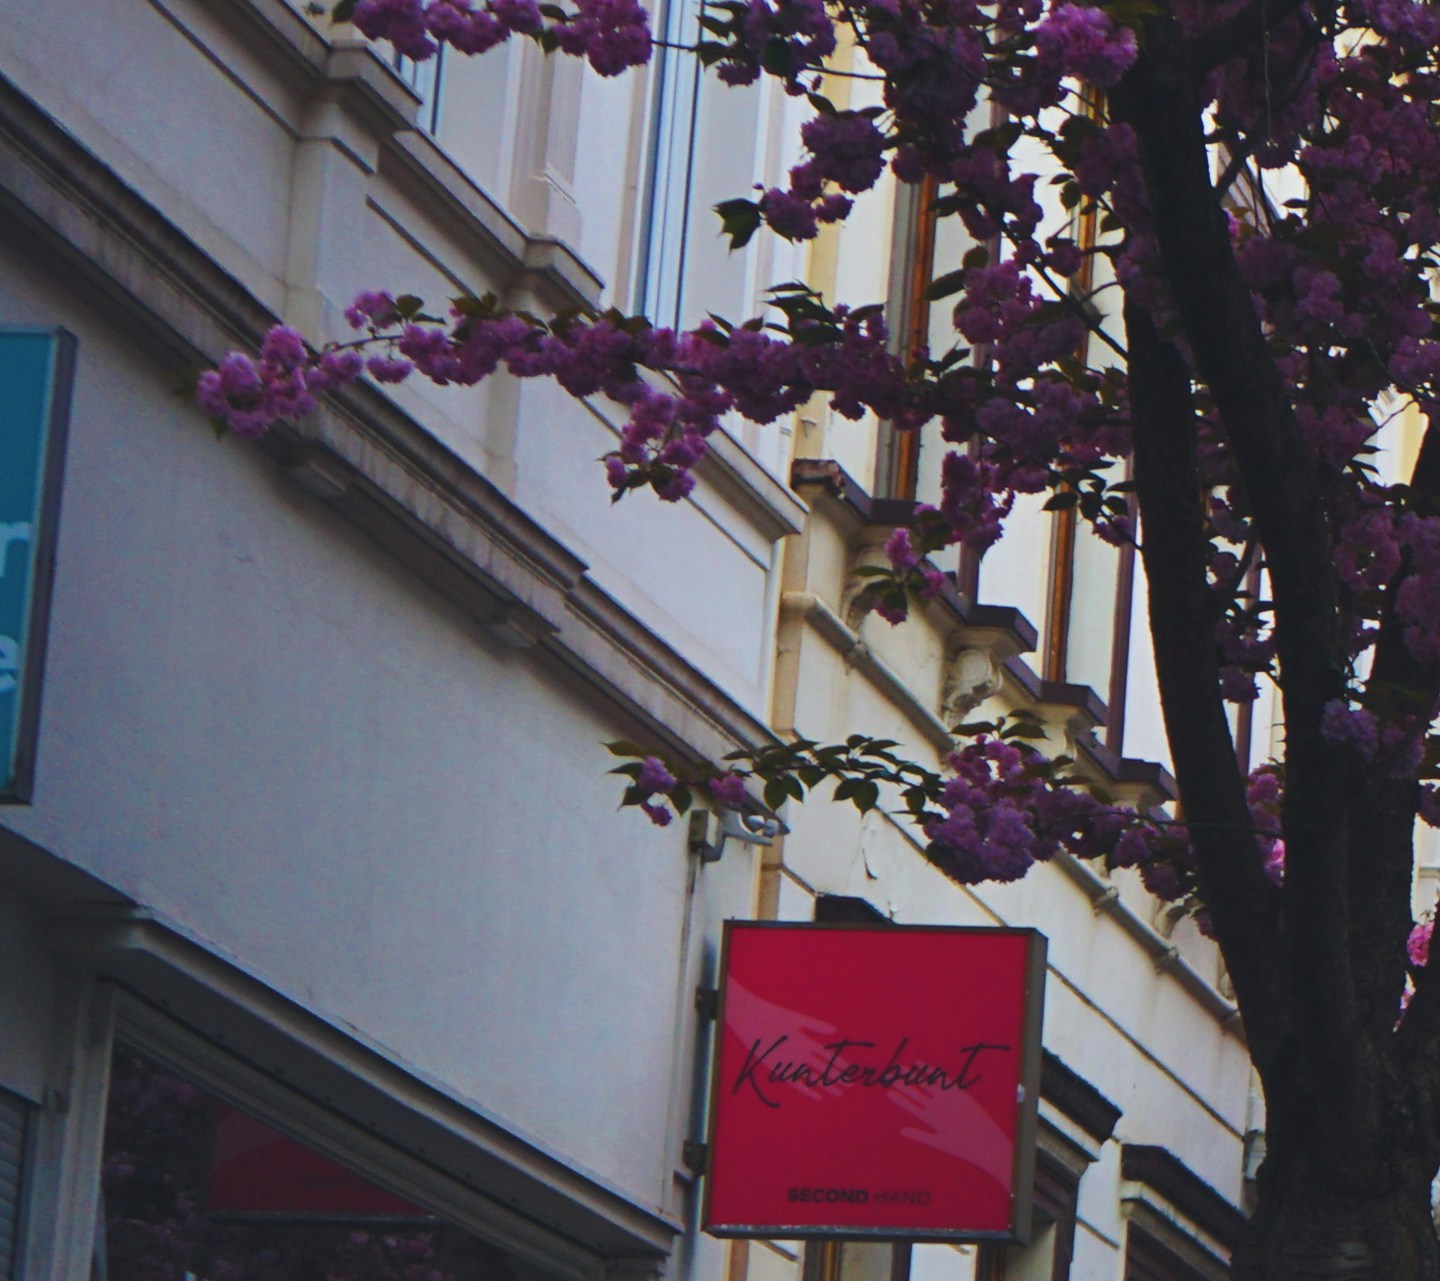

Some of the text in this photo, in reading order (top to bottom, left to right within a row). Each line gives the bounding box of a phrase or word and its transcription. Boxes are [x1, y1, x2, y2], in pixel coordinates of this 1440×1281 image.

[732, 1035, 1011, 1108] Kunterbunt
[788, 1187, 932, 1206] SECOND HAND
